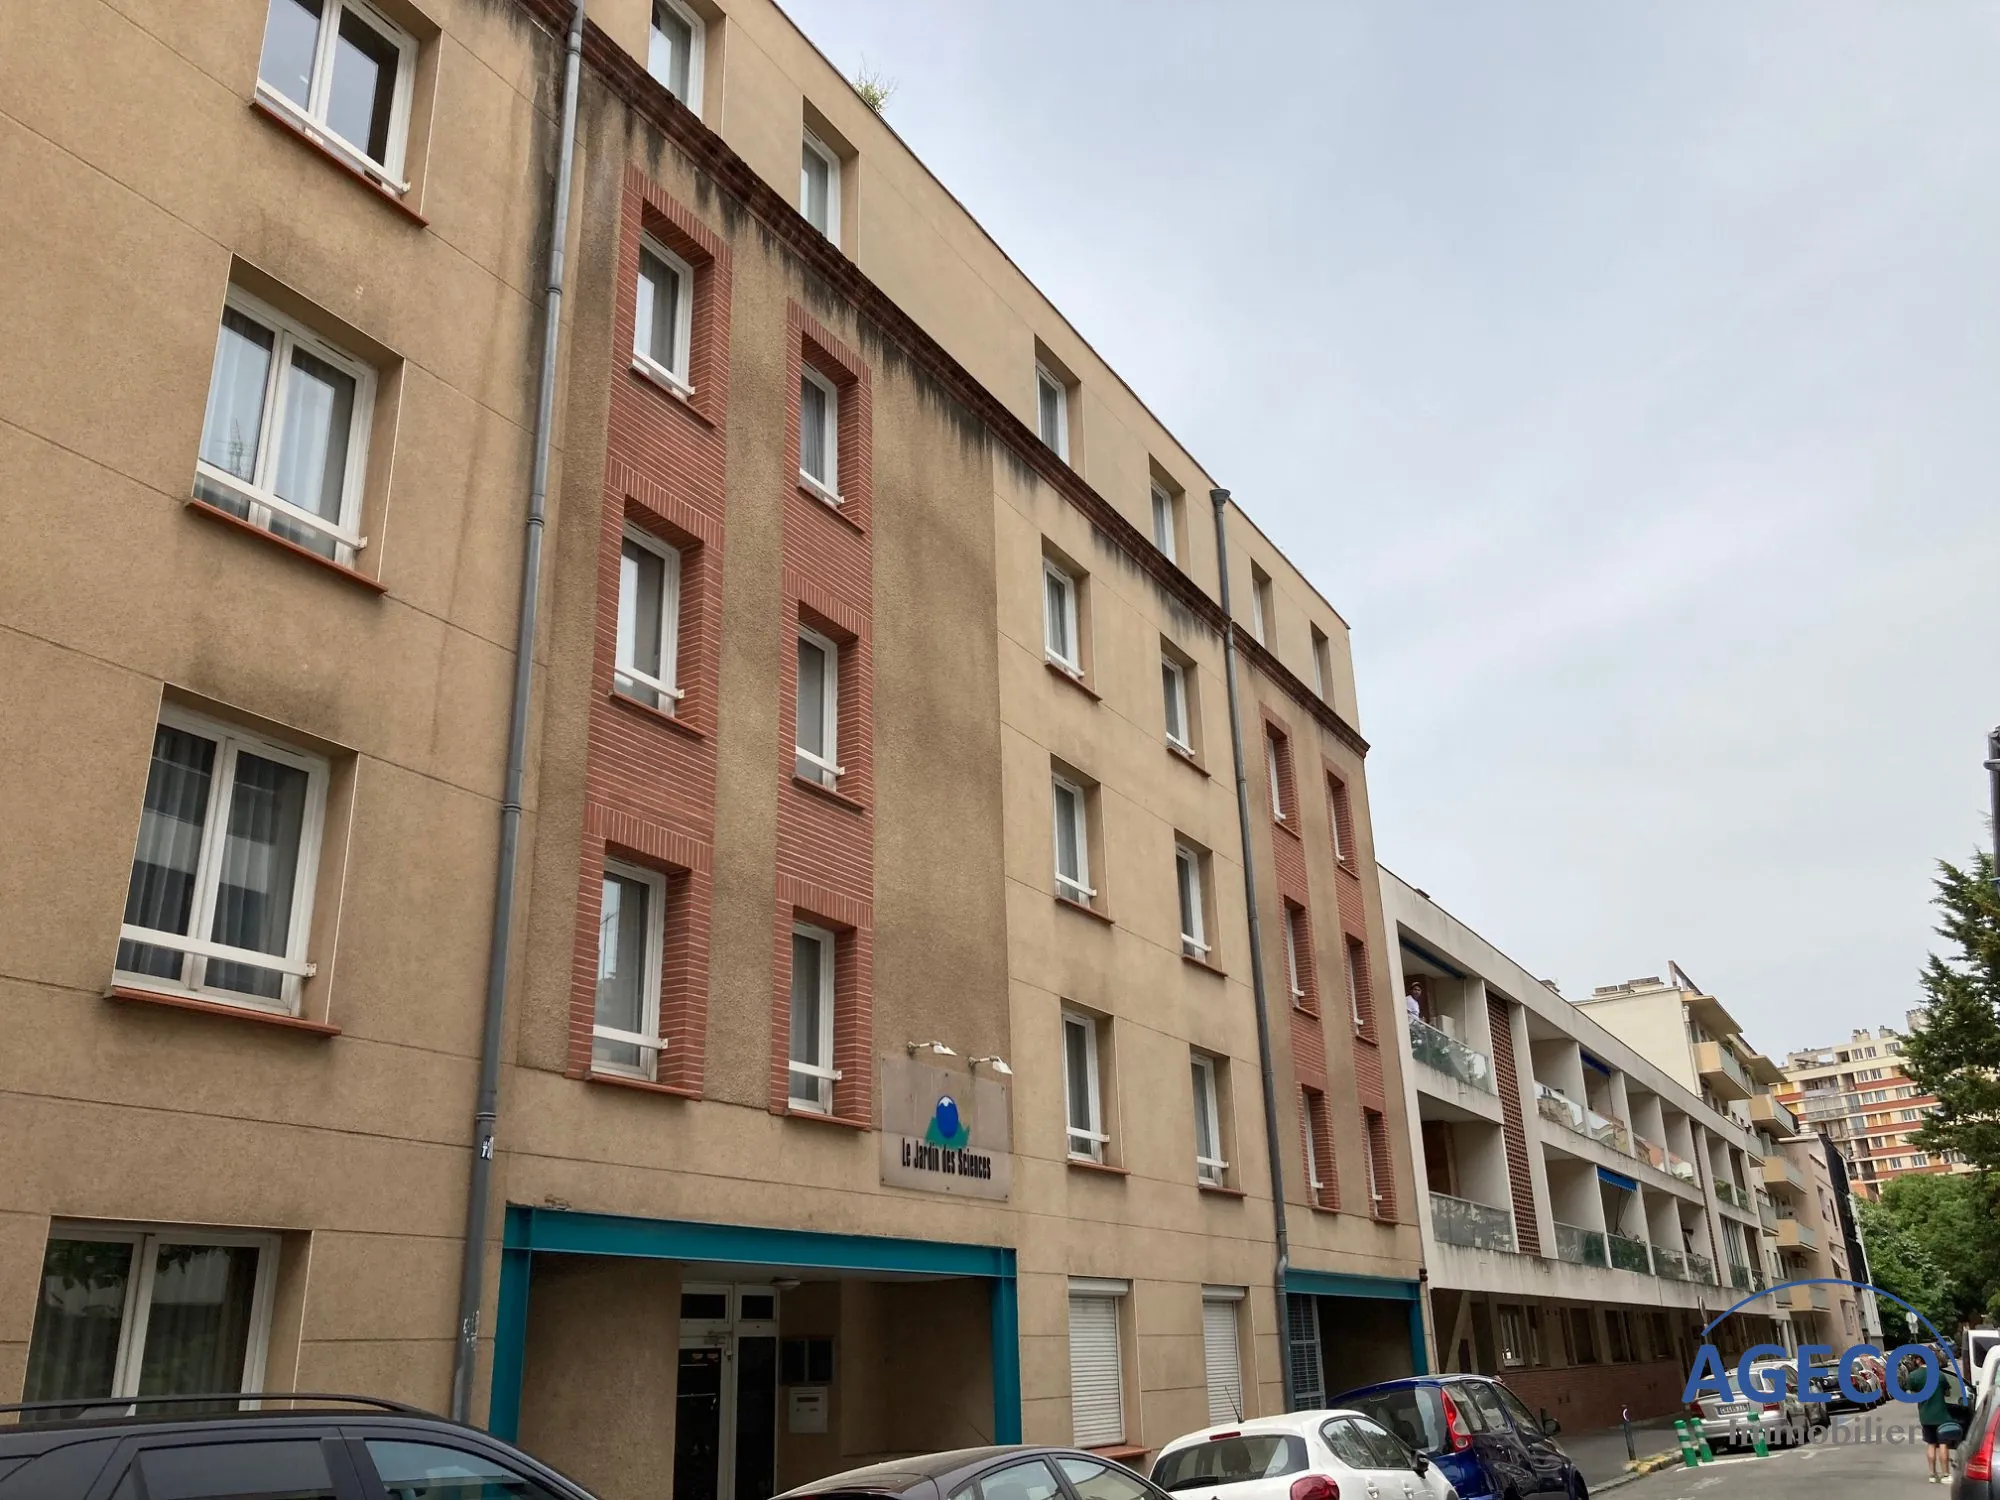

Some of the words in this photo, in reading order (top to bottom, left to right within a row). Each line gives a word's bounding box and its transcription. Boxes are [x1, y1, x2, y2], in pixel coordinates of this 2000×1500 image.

[902, 1137, 911, 1167] Le
[914, 1140, 939, 1172] Jardin
[942, 1144, 955, 1174] des
[958, 1148, 991, 1180] Sciences
